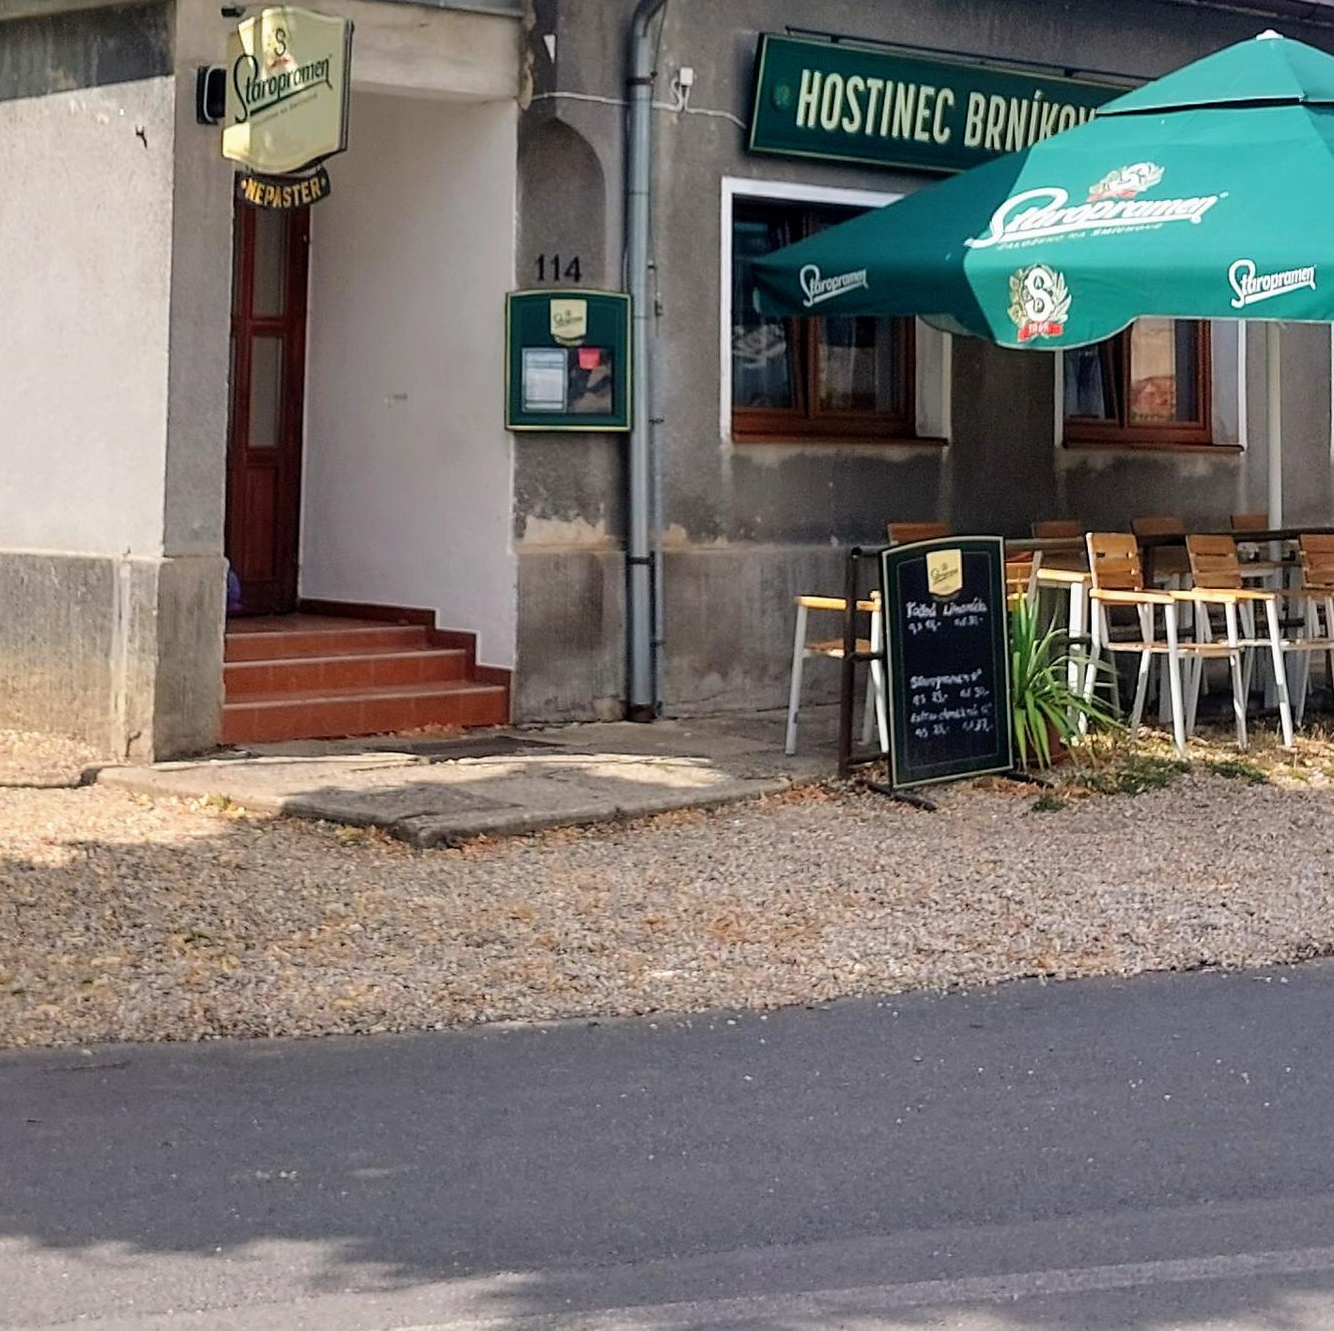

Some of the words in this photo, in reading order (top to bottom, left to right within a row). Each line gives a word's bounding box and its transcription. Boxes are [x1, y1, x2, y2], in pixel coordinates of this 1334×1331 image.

[233, 55, 333, 124] Staropramen
[796, 69, 955, 145] HOSTINEC
[244, 177, 323, 208] NEPASTER
[964, 187, 1218, 250] Staropramen
[534, 253, 582, 283] 114
[799, 264, 870, 308] Staropramen
[1228, 259, 1317, 309] Staropramen
